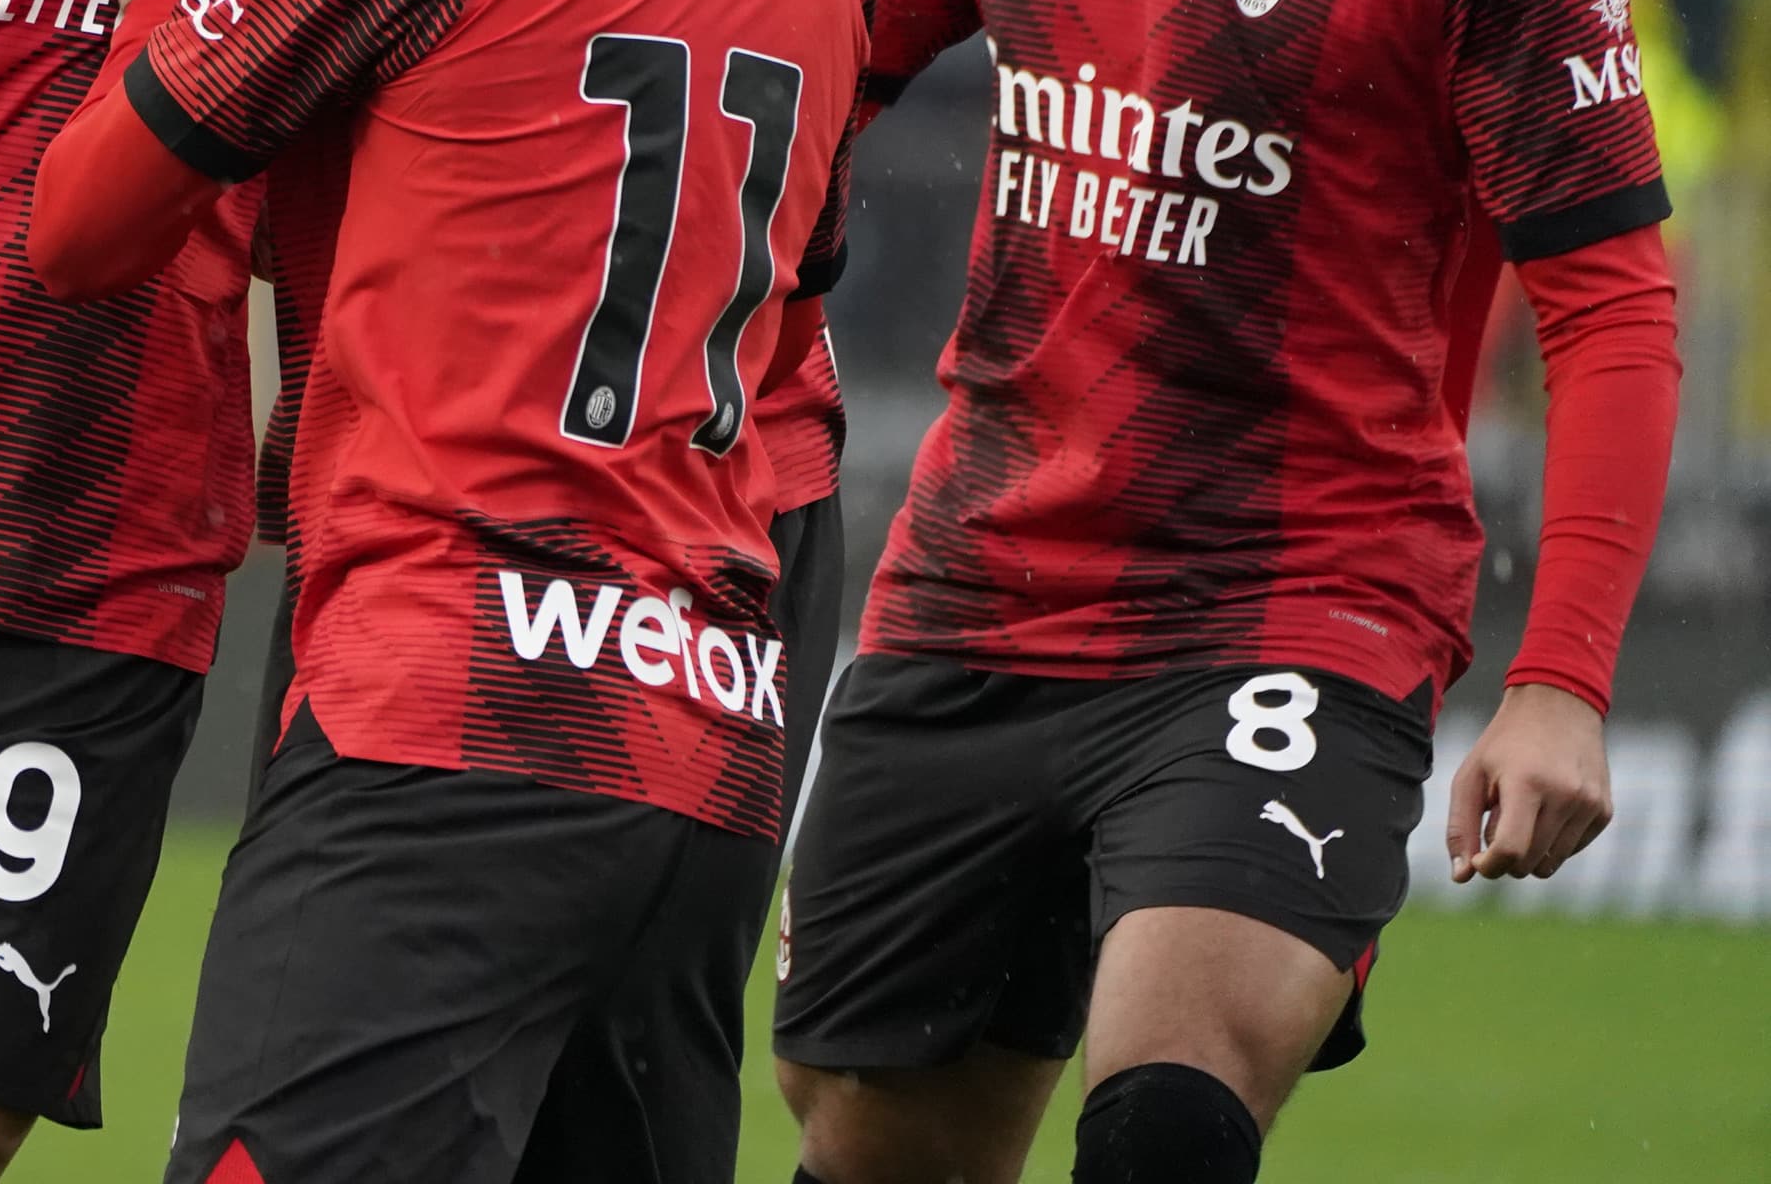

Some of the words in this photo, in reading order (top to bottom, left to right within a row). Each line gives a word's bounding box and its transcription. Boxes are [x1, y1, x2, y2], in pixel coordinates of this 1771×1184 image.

[986, 36, 1294, 197] mirates
[1562, 42, 1642, 110] MS
[559, 32, 803, 460] 11
[995, 149, 1061, 229] FLY
[498, 570, 785, 727] wefox
[1225, 671, 1320, 772] 8
